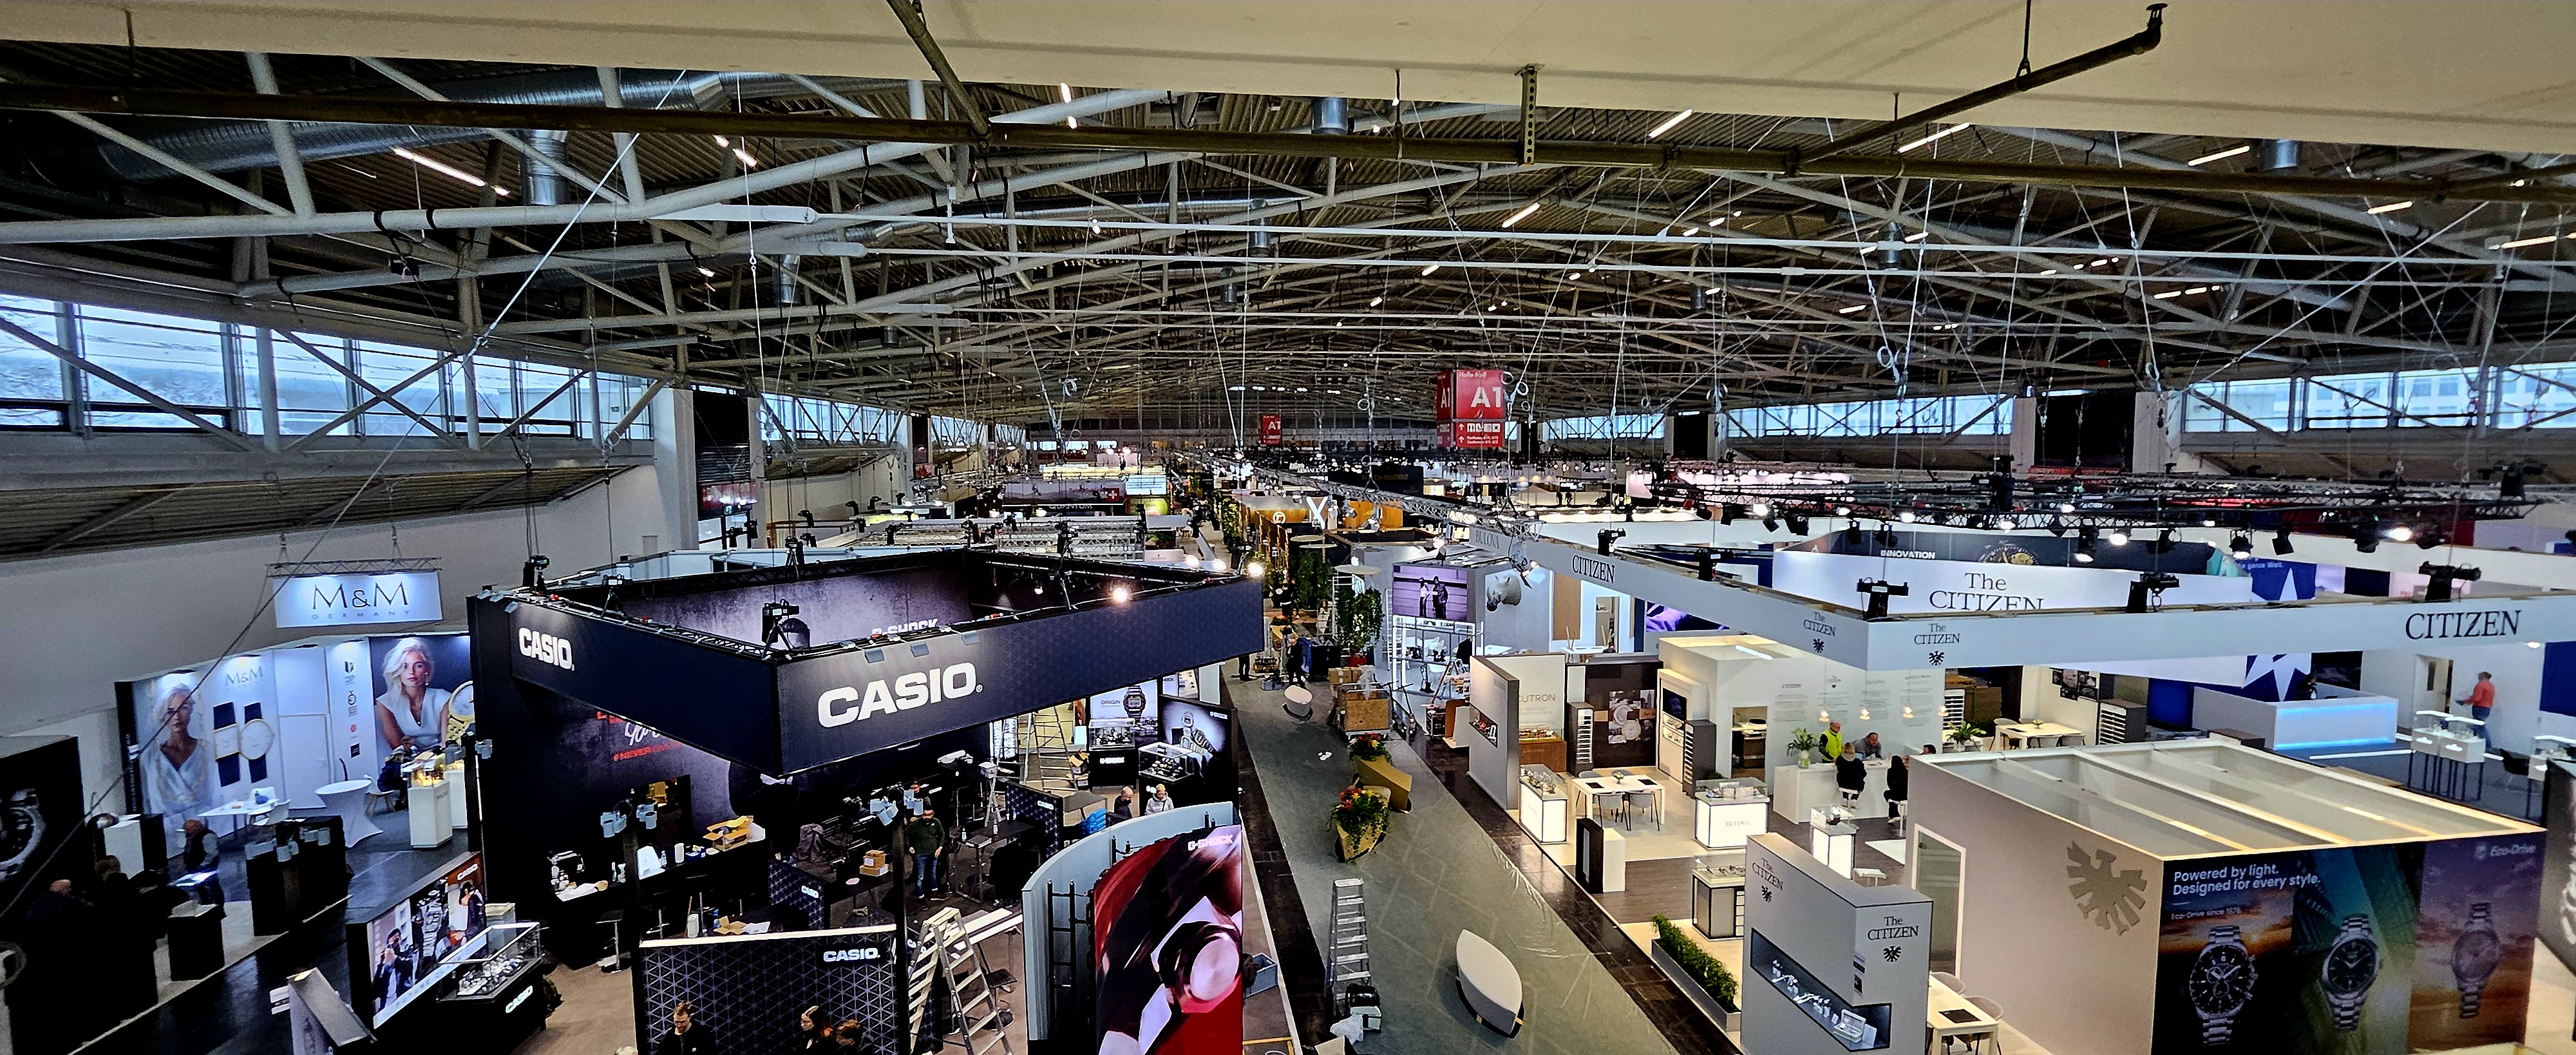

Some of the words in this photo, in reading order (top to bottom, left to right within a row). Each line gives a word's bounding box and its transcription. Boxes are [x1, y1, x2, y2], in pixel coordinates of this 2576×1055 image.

[1441, 387, 1450, 408] A1
[1470, 386, 1501, 407] A1
[1268, 421, 1281, 430] A1
[1475, 529, 1499, 549] BULOVA
[1572, 555, 1615, 584] CITIZEN
[1964, 572, 2007, 591] The
[312, 581, 408, 609] M&M
[1929, 590, 2045, 613] CITIZEN
[311, 610, 410, 620] GERMANY
[1814, 611, 1826, 623] The
[2405, 609, 2522, 640] CITIZEN
[1803, 619, 1837, 636] CITIZEN
[1929, 623, 1947, 632] The
[1913, 632, 1961, 645] CITIZEN
[226, 665, 263, 687] M&M
[1188, 834, 1234, 851] G-SHOCK
[1761, 857, 1774, 873] The
[2174, 867, 2228, 882] Powered
[2231, 866, 2247, 879] by
[2249, 863, 2279, 879] light.
[1752, 862, 1783, 891] CITIZEN
[2173, 879, 2231, 897] Designed
[2233, 879, 2250, 890] for
[2252, 877, 2287, 889] every
[2289, 872, 2321, 888] style.
[1884, 915, 1904, 926] The
[1868, 925, 1919, 941] CITIZEN
